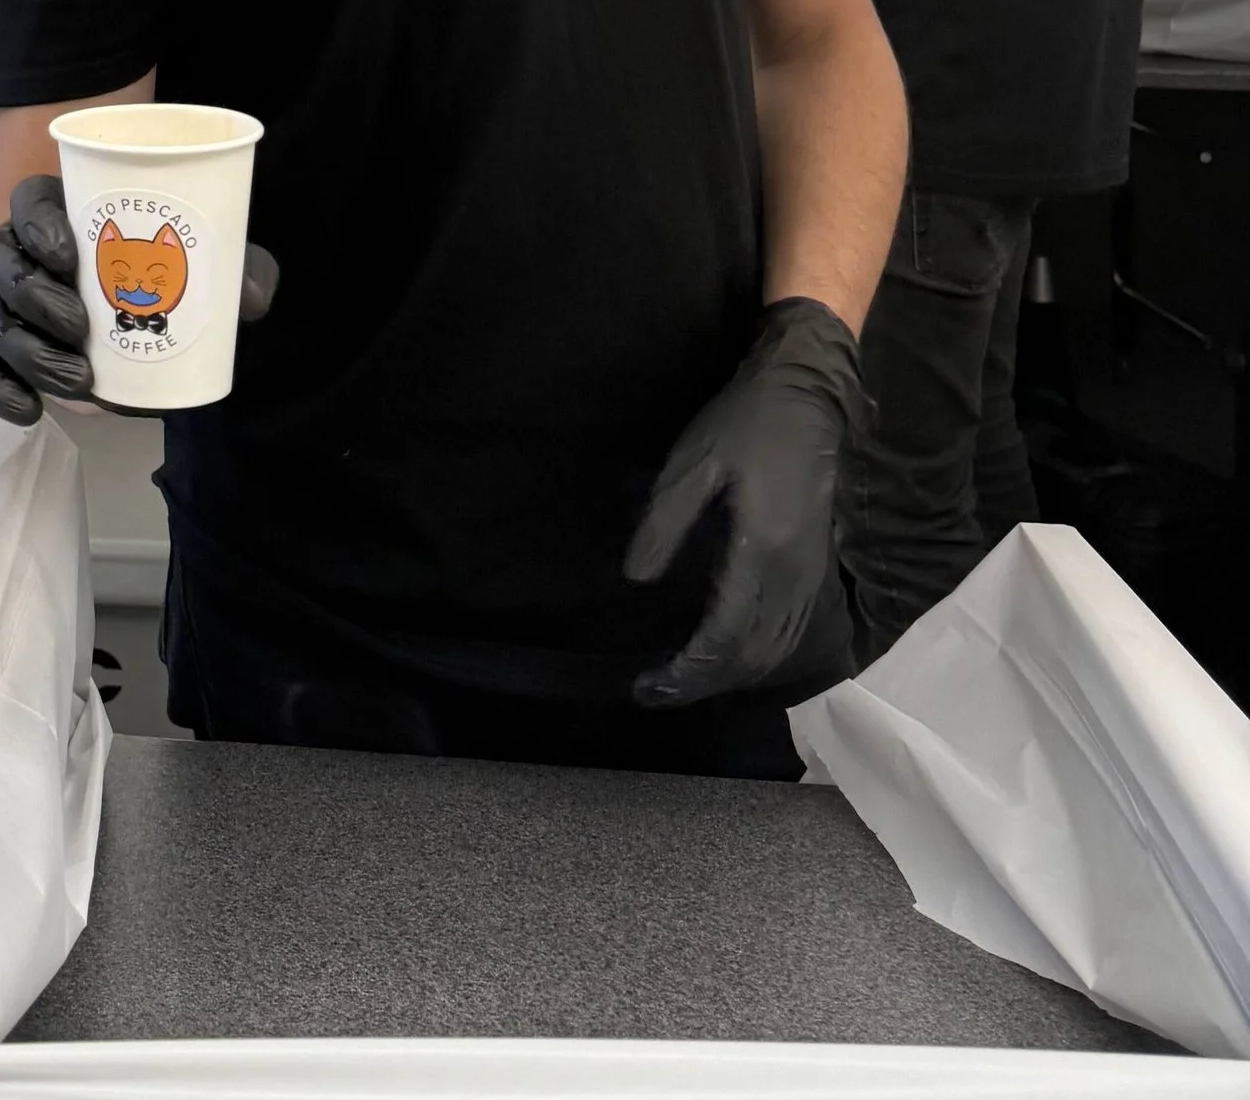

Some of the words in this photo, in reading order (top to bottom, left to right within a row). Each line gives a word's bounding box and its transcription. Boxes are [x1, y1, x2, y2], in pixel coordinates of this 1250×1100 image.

[87, 202, 116, 242] GATO
[121, 198, 198, 249] PESCADO
[109, 329, 177, 355] COFFEE
